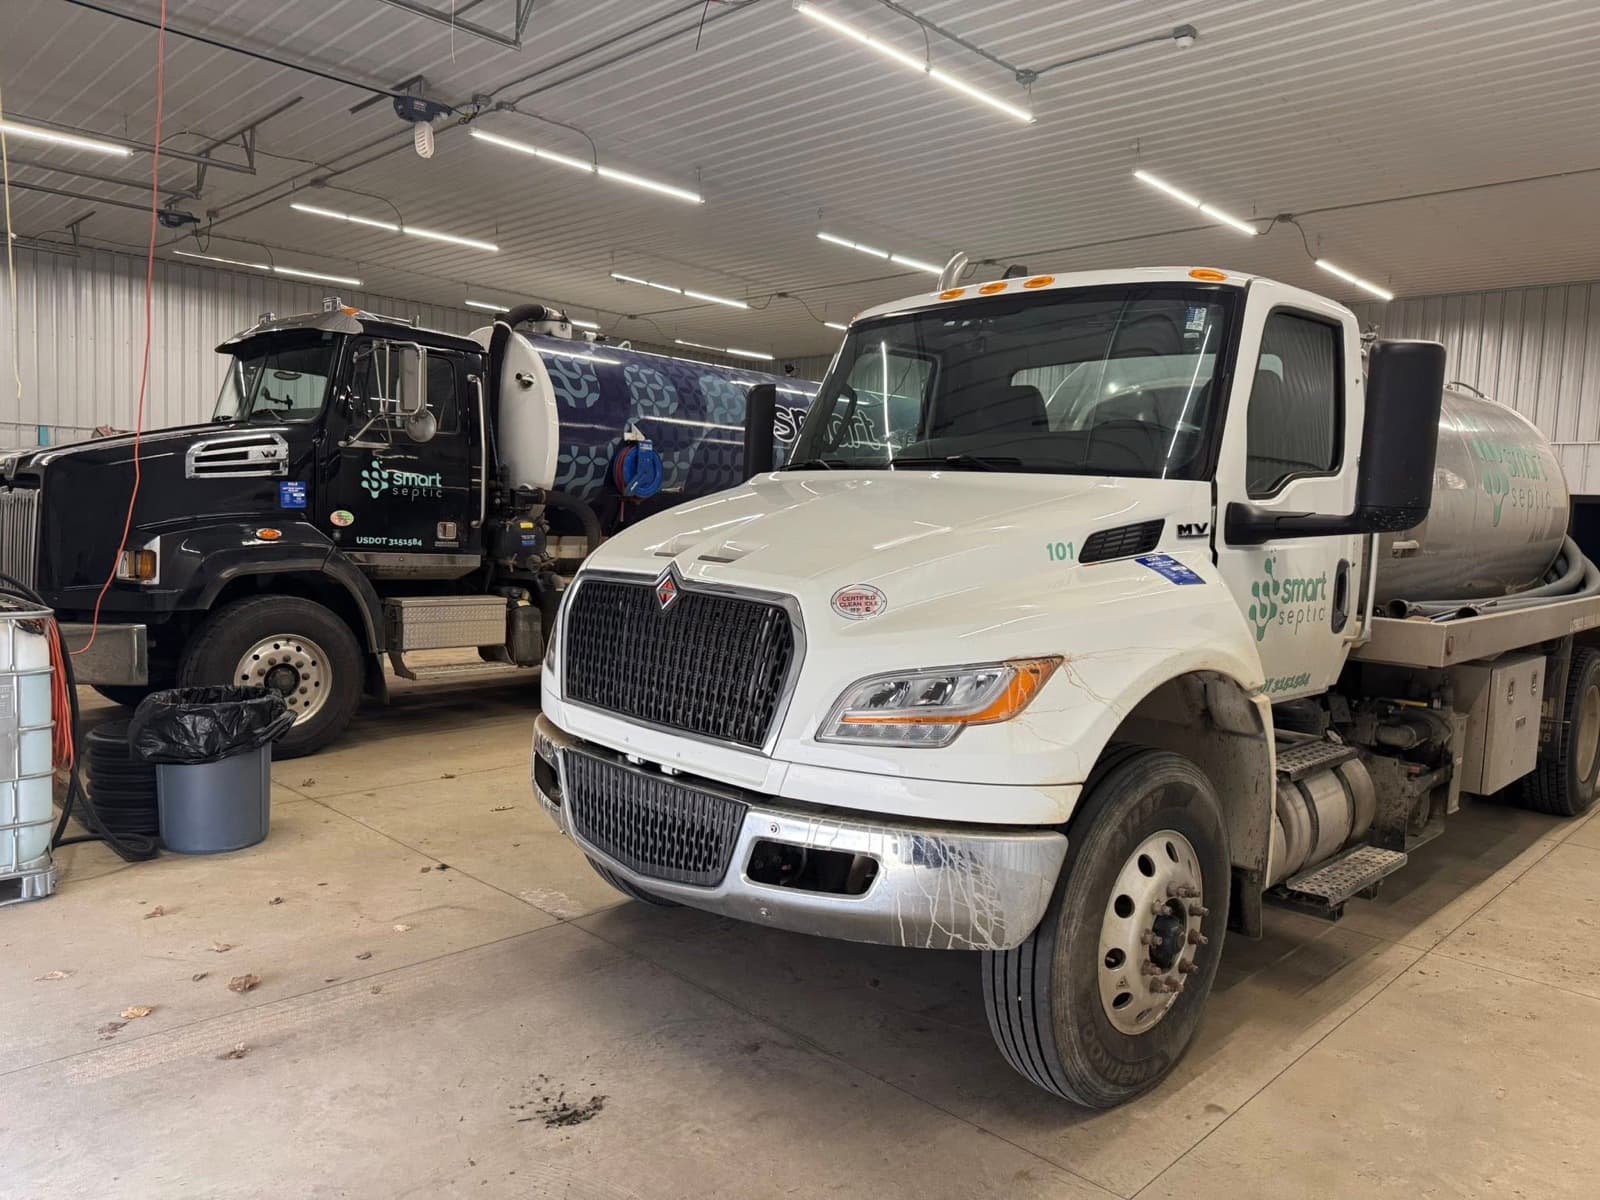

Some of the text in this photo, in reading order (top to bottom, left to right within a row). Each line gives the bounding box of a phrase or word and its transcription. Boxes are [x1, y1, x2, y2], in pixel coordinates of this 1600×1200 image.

[392, 472, 442, 488] smart
[392, 487, 443, 502] septic
[1177, 522, 1209, 536] MV
[356, 536, 388, 545] USDOT
[1046, 541, 1075, 561] 101
[1281, 571, 1328, 604] smart
[1278, 604, 1327, 636] septic
